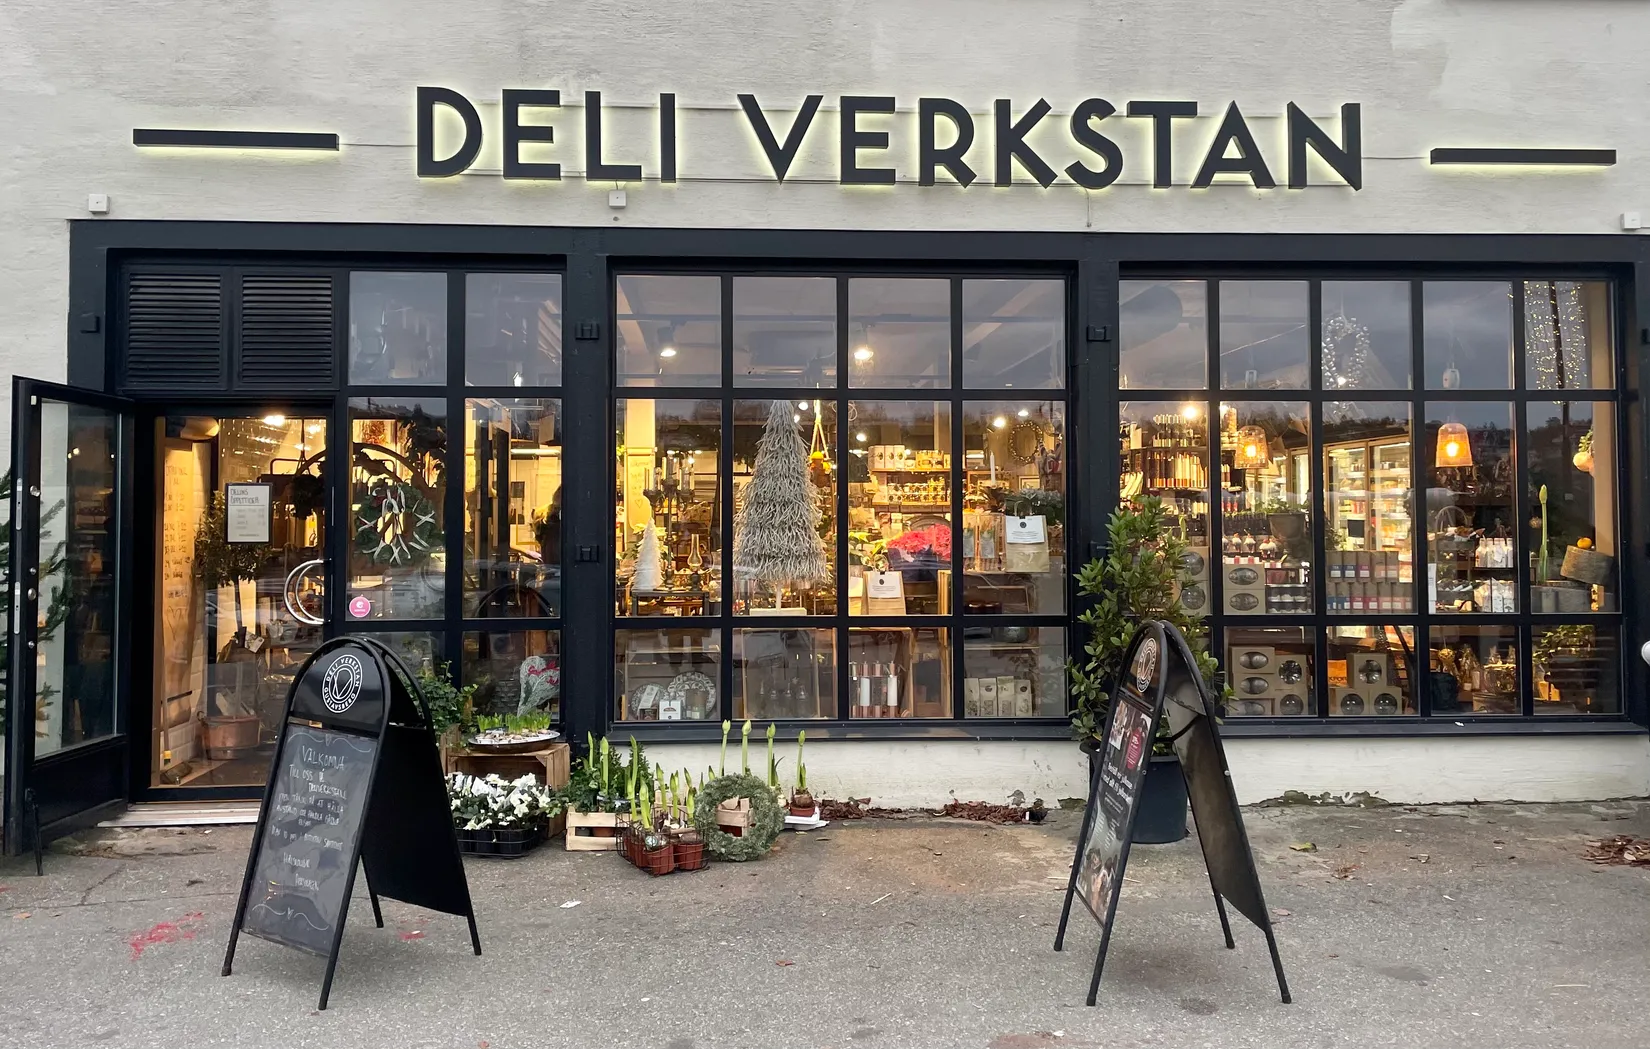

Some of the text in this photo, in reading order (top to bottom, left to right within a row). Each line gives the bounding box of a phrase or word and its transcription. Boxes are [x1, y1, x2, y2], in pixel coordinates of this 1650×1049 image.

[417, 86, 1362, 191] DELI VERKSTAN
[326, 657, 361, 687] DELI VERKSTAN
[324, 687, 356, 710] GUSTAVSBERG
[302, 769, 313, 781] OSS
